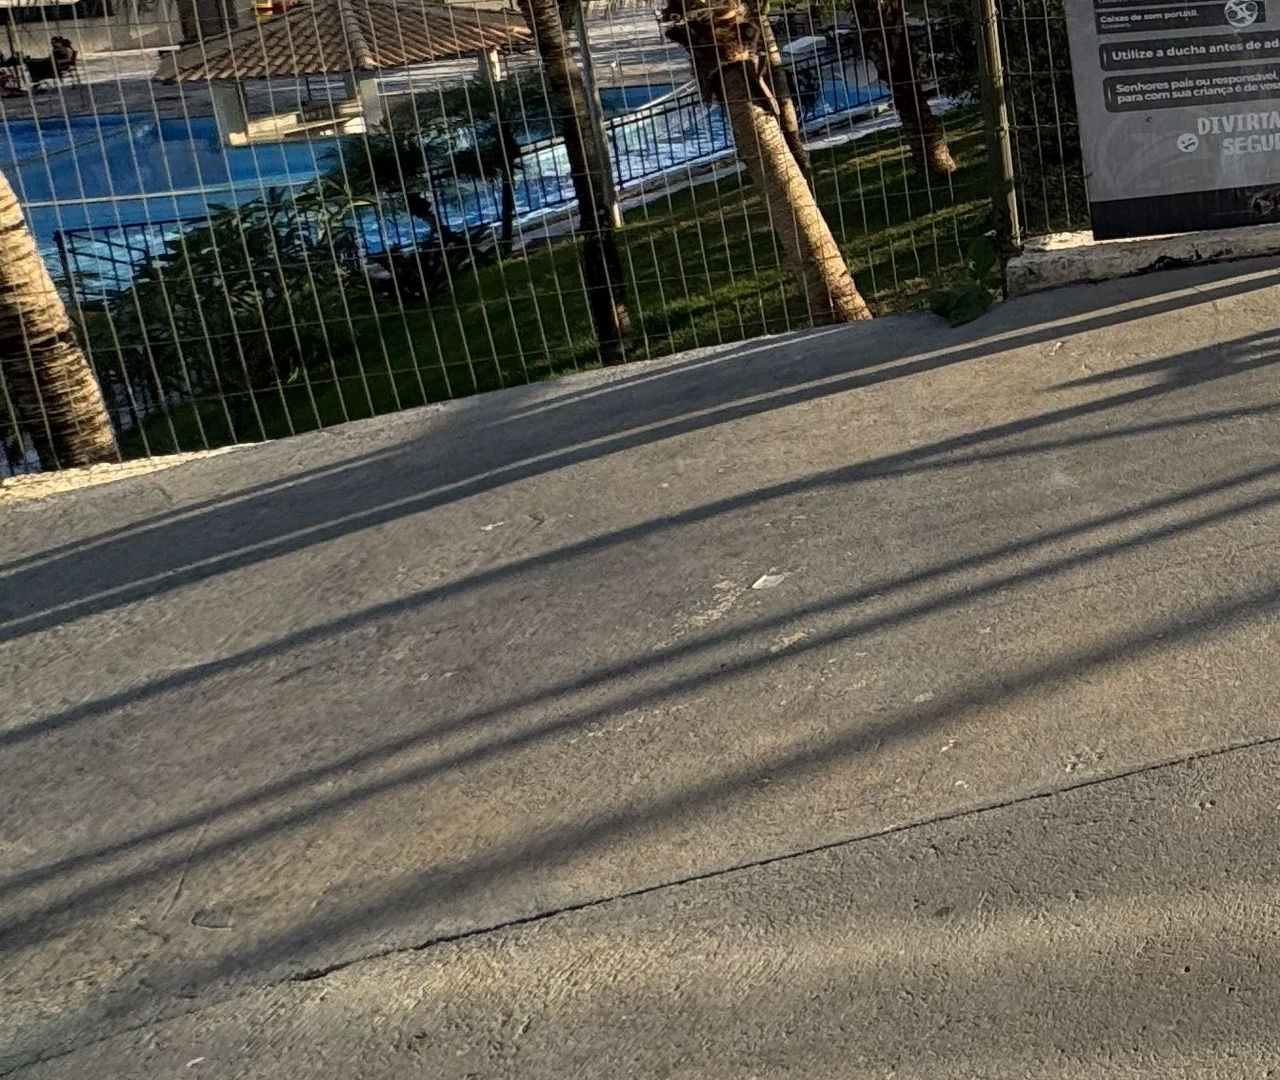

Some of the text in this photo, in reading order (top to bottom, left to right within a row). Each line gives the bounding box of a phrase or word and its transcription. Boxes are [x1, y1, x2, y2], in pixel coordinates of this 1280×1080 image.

[1100, 13, 1128, 22] Caixas
[1111, 48, 1153, 60] Utilize
[1156, 49, 1163, 57] a
[1166, 44, 1206, 56] ducha
[1208, 41, 1243, 53] antes
[1245, 39, 1261, 50] de
[1115, 79, 1169, 92] Senhores
[1170, 77, 1193, 90] pais
[1195, 78, 1209, 86] ou
[1117, 93, 1143, 104] para
[1144, 91, 1169, 101] com
[1171, 89, 1191, 98] sua
[1192, 83, 1233, 98] criança
[1234, 83, 1242, 92] é
[1243, 81, 1258, 92] de
